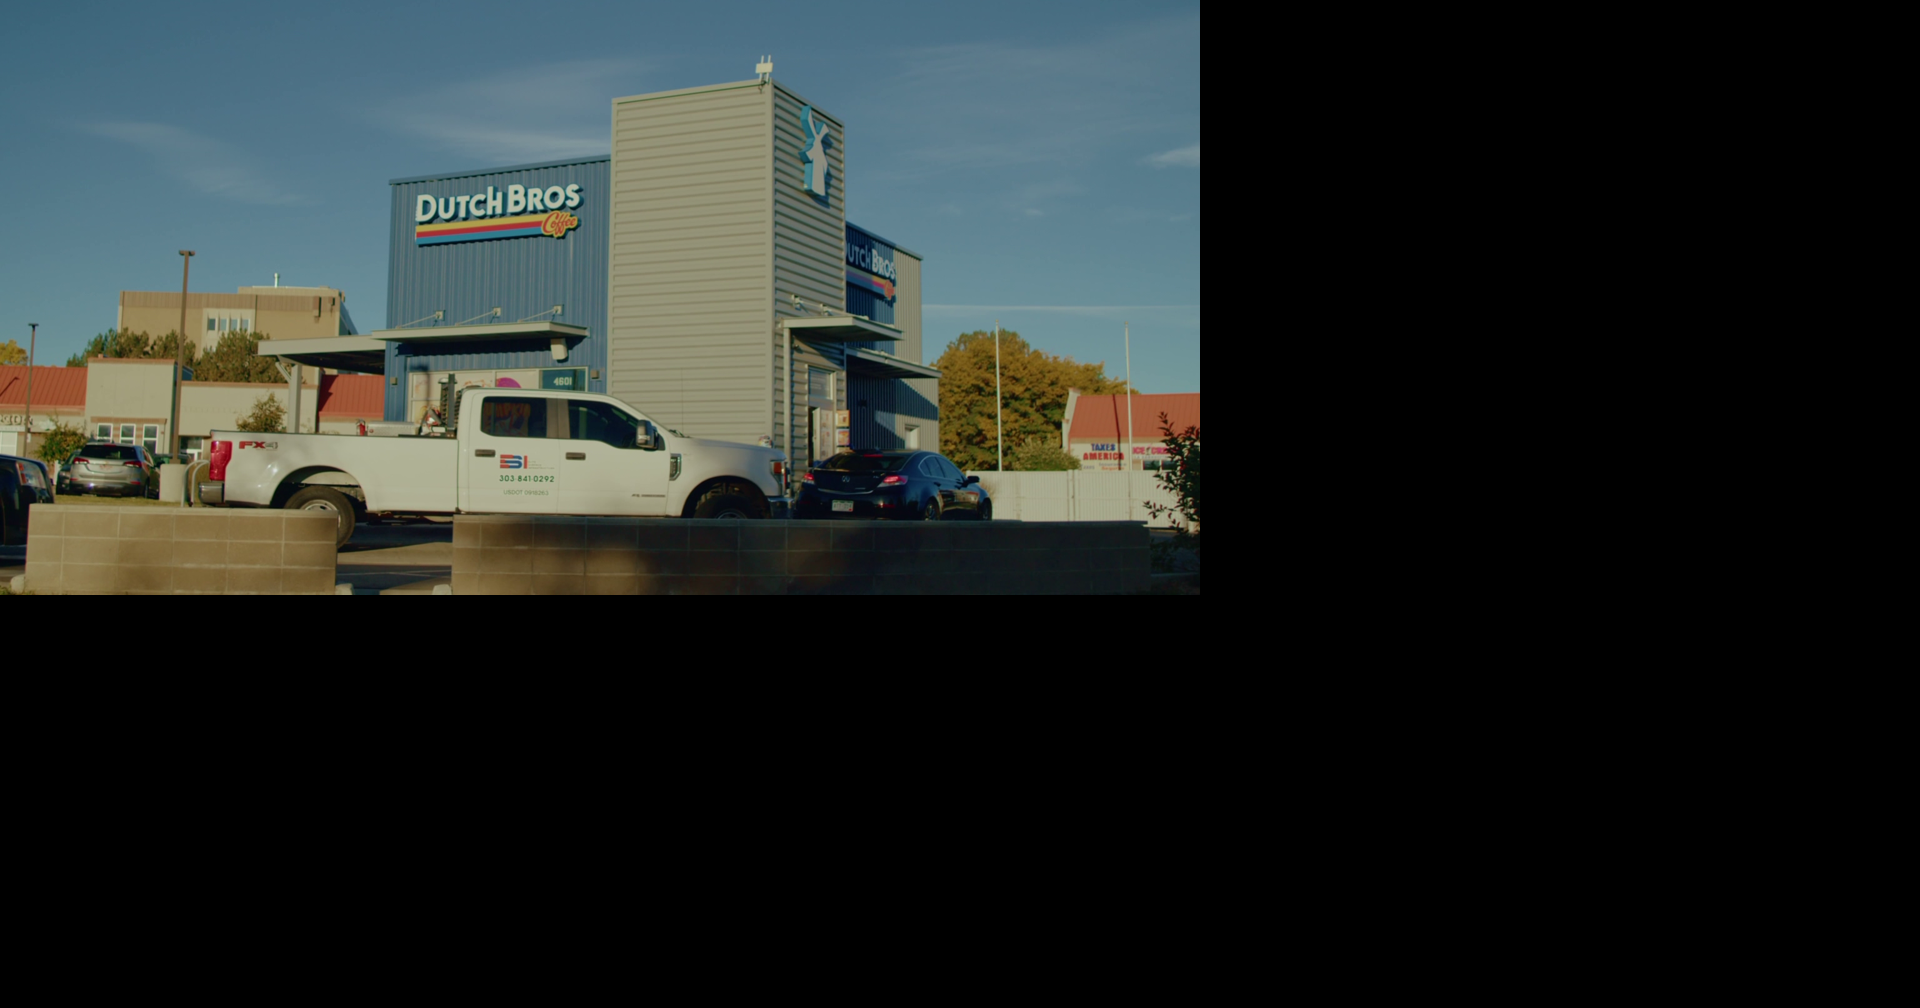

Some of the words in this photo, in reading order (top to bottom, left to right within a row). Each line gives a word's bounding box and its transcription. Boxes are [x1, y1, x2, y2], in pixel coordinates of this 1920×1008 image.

[415, 186, 503, 223] DUTCH
[507, 184, 581, 215] BROS
[542, 210, 577, 236] Coffee
[871, 248, 896, 280] BROS
[553, 377, 572, 386] 4601
[1091, 443, 1116, 452] TAXES
[1132, 446, 1145, 455] ICE
[1083, 452, 1125, 461] AMERICA
